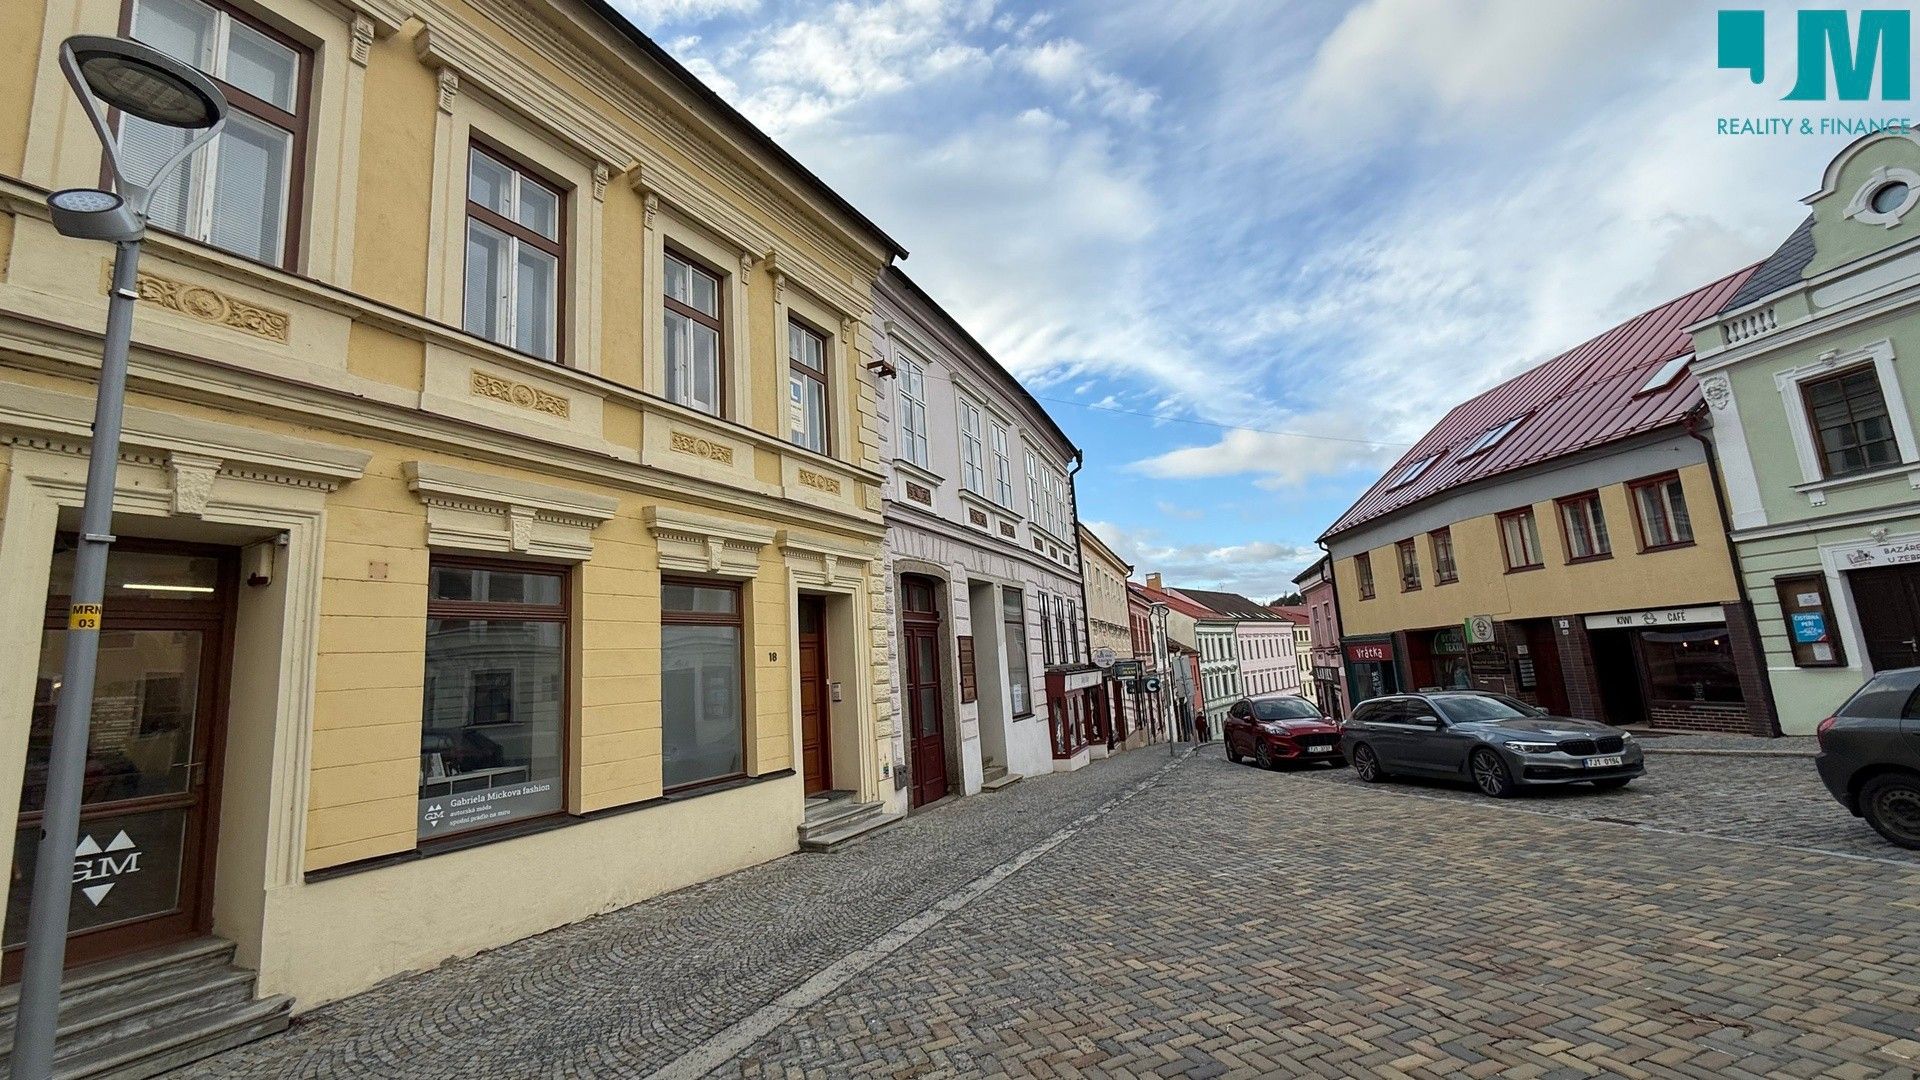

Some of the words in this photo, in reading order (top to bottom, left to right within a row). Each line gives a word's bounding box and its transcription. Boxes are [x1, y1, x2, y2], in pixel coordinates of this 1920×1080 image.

[73, 605, 102, 615] MRN
[1615, 615, 1633, 625] KIWI
[1667, 609, 1686, 622] CAFÉ
[78, 618, 95, 628] 03
[768, 652, 777, 662] 18
[450, 795, 486, 807] Gabriela
[522, 784, 550, 795] fashion
[424, 810, 445, 821] GM
